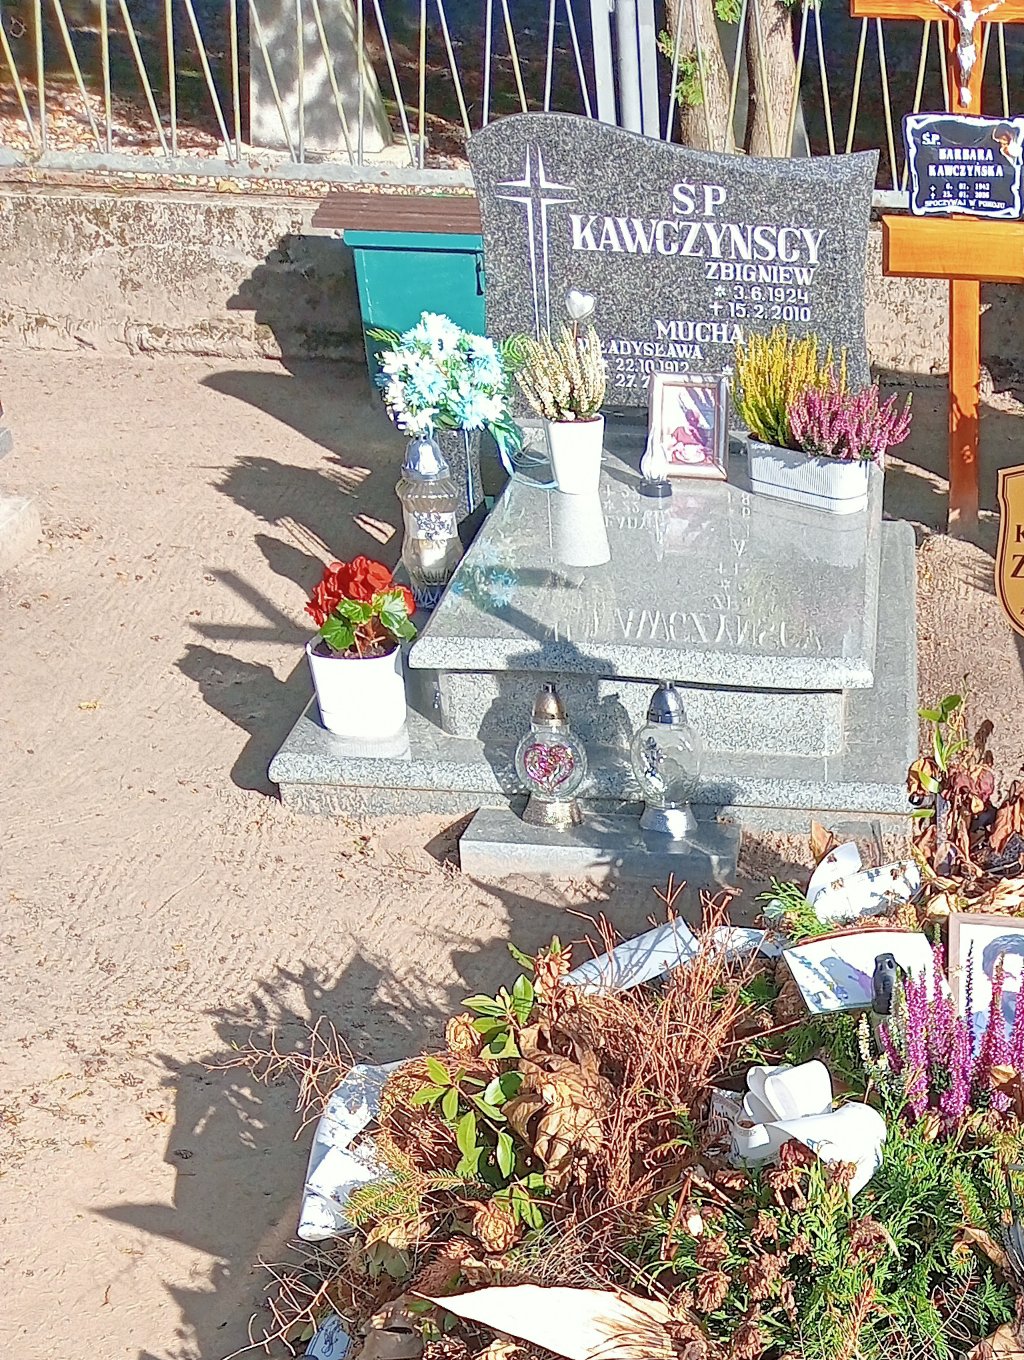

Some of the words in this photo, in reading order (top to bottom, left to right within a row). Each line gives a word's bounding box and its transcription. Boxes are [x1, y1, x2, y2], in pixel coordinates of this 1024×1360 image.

[939, 148, 994, 161] BARBARA
[928, 162, 1004, 177] KAWCZYŃSKA
[705, 261, 816, 287] ZBIGNIEW
[655, 319, 746, 345] MUCHA
